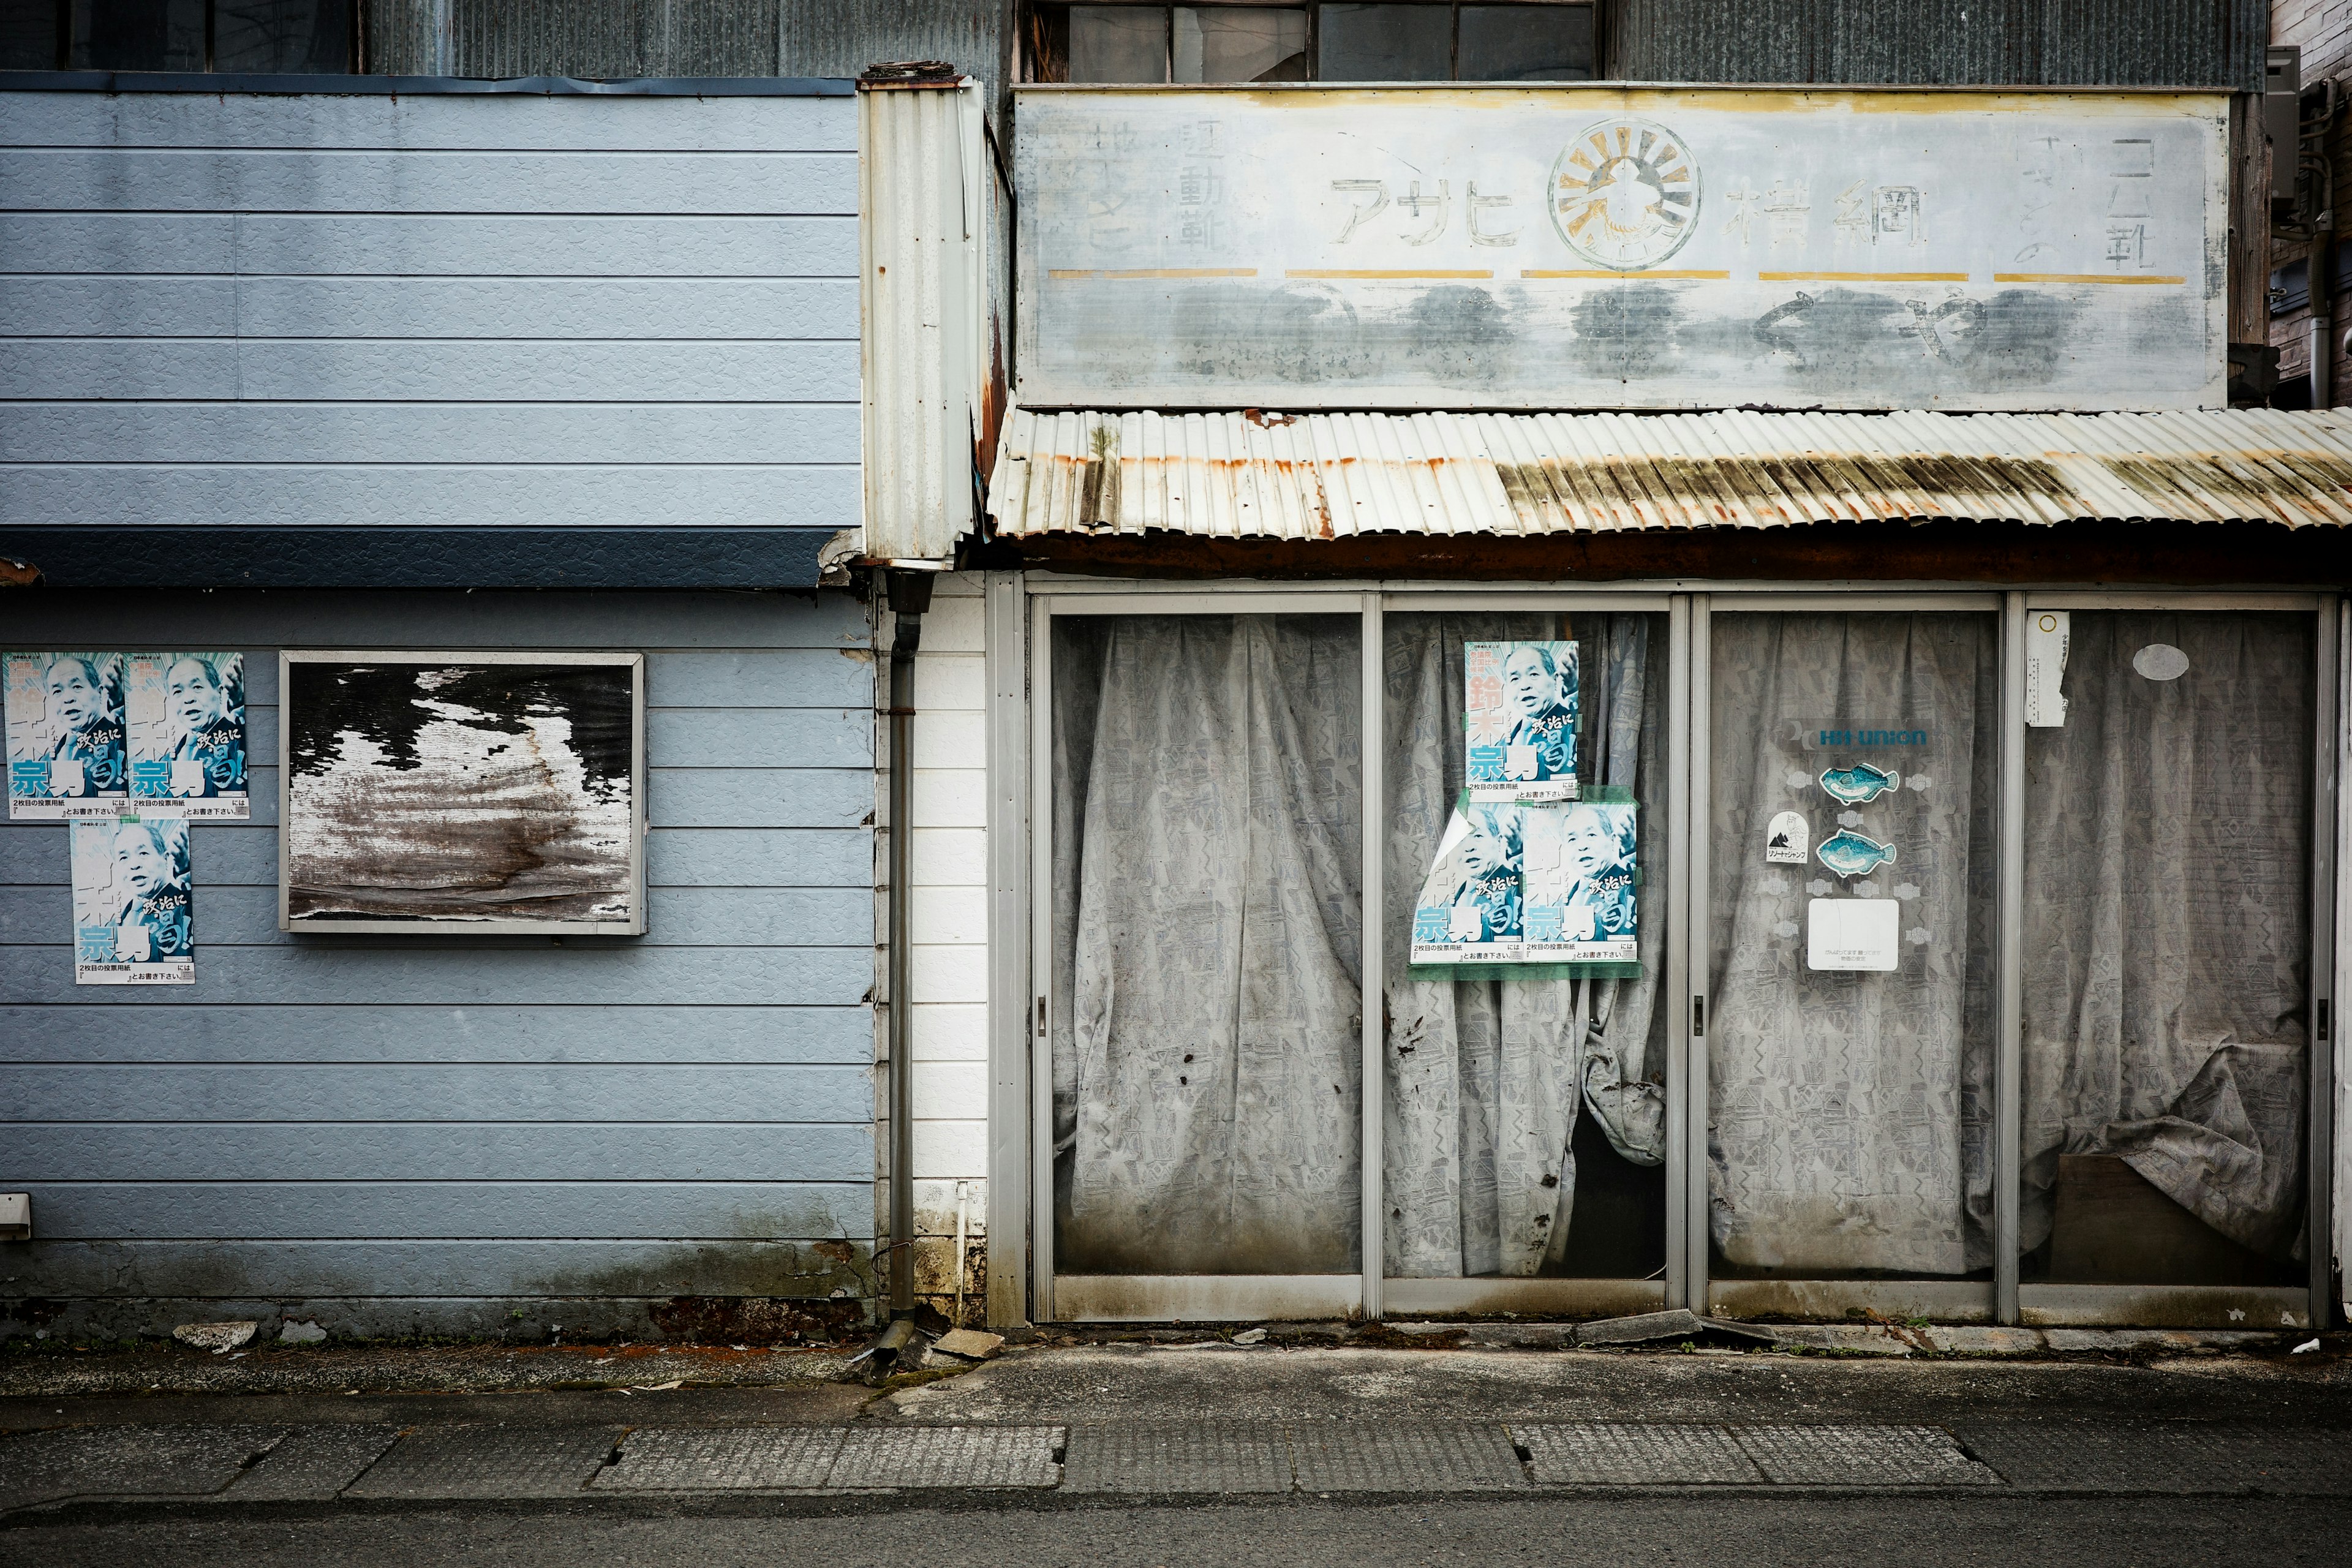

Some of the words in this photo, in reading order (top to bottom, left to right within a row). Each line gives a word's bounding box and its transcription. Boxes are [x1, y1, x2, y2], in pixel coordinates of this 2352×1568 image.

[1330, 178, 1524, 247] アサヒ
[1722, 176, 1921, 249] 横綱
[1468, 675, 1506, 747] 鈴木
[1531, 714, 1574, 737] 政治に
[77, 728, 121, 752] 政治に
[197, 728, 241, 752] 政治に
[1469, 744, 1539, 781] 宗男
[1476, 875, 1519, 899] 政治に
[1588, 874, 1632, 897] 政治に
[142, 894, 187, 918] 政治に
